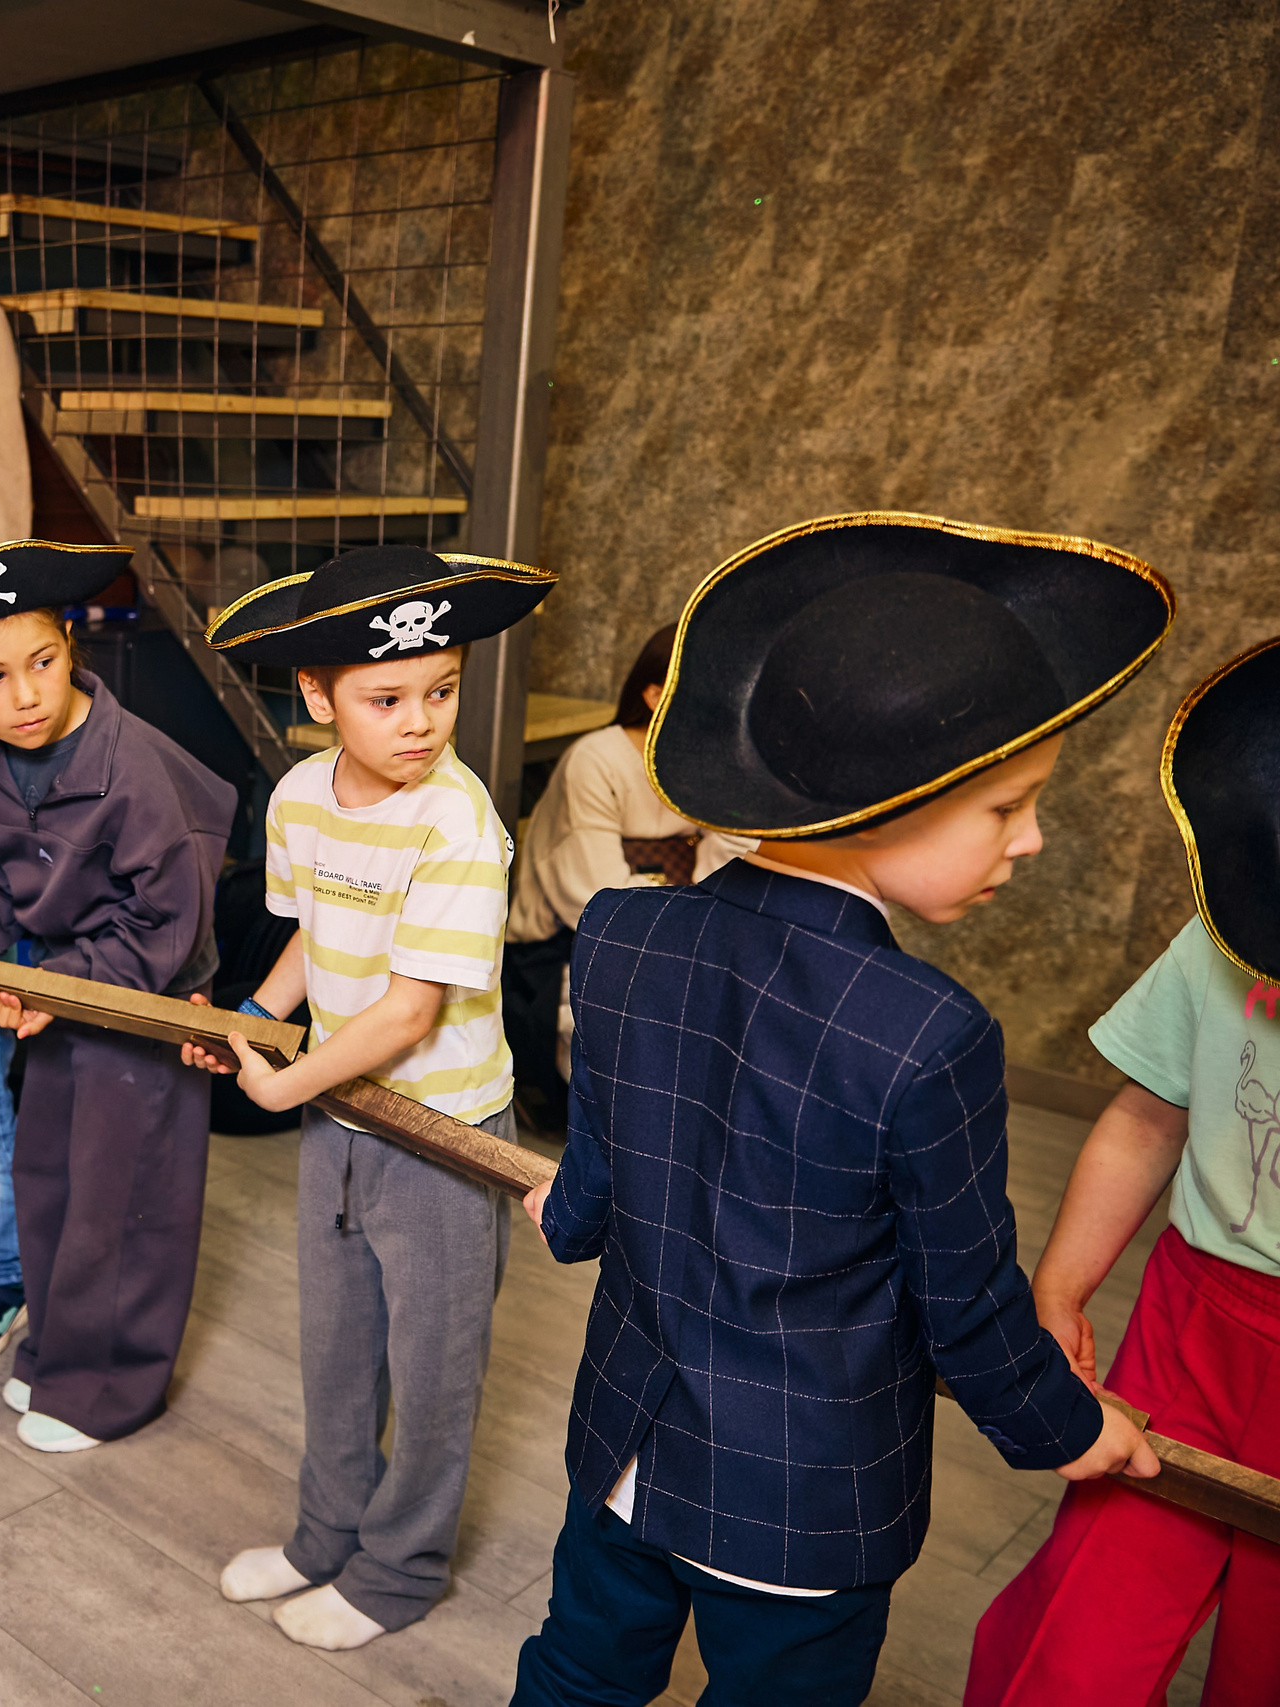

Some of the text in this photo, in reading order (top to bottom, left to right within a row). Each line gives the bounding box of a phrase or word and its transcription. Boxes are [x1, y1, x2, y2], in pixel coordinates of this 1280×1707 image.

[318, 869, 345, 881] BOARD
[345, 876, 359, 886] WILL
[337, 891, 352, 900] BEST
